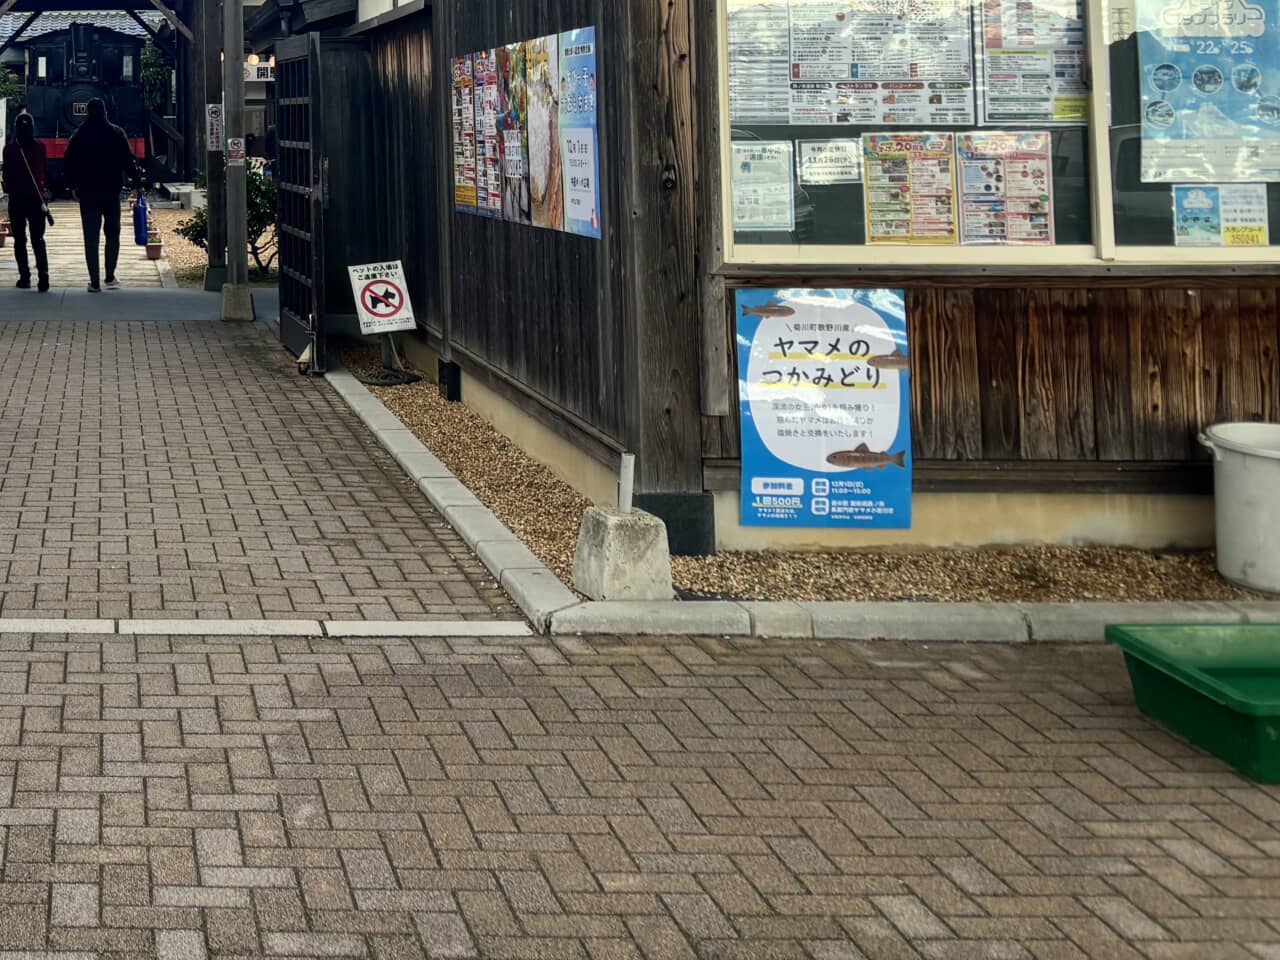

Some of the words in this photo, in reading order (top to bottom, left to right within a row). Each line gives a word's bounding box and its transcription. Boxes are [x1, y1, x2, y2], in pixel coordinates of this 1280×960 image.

[773, 336, 870, 358] ヤマメの
[762, 366, 881, 389] つかみどり
